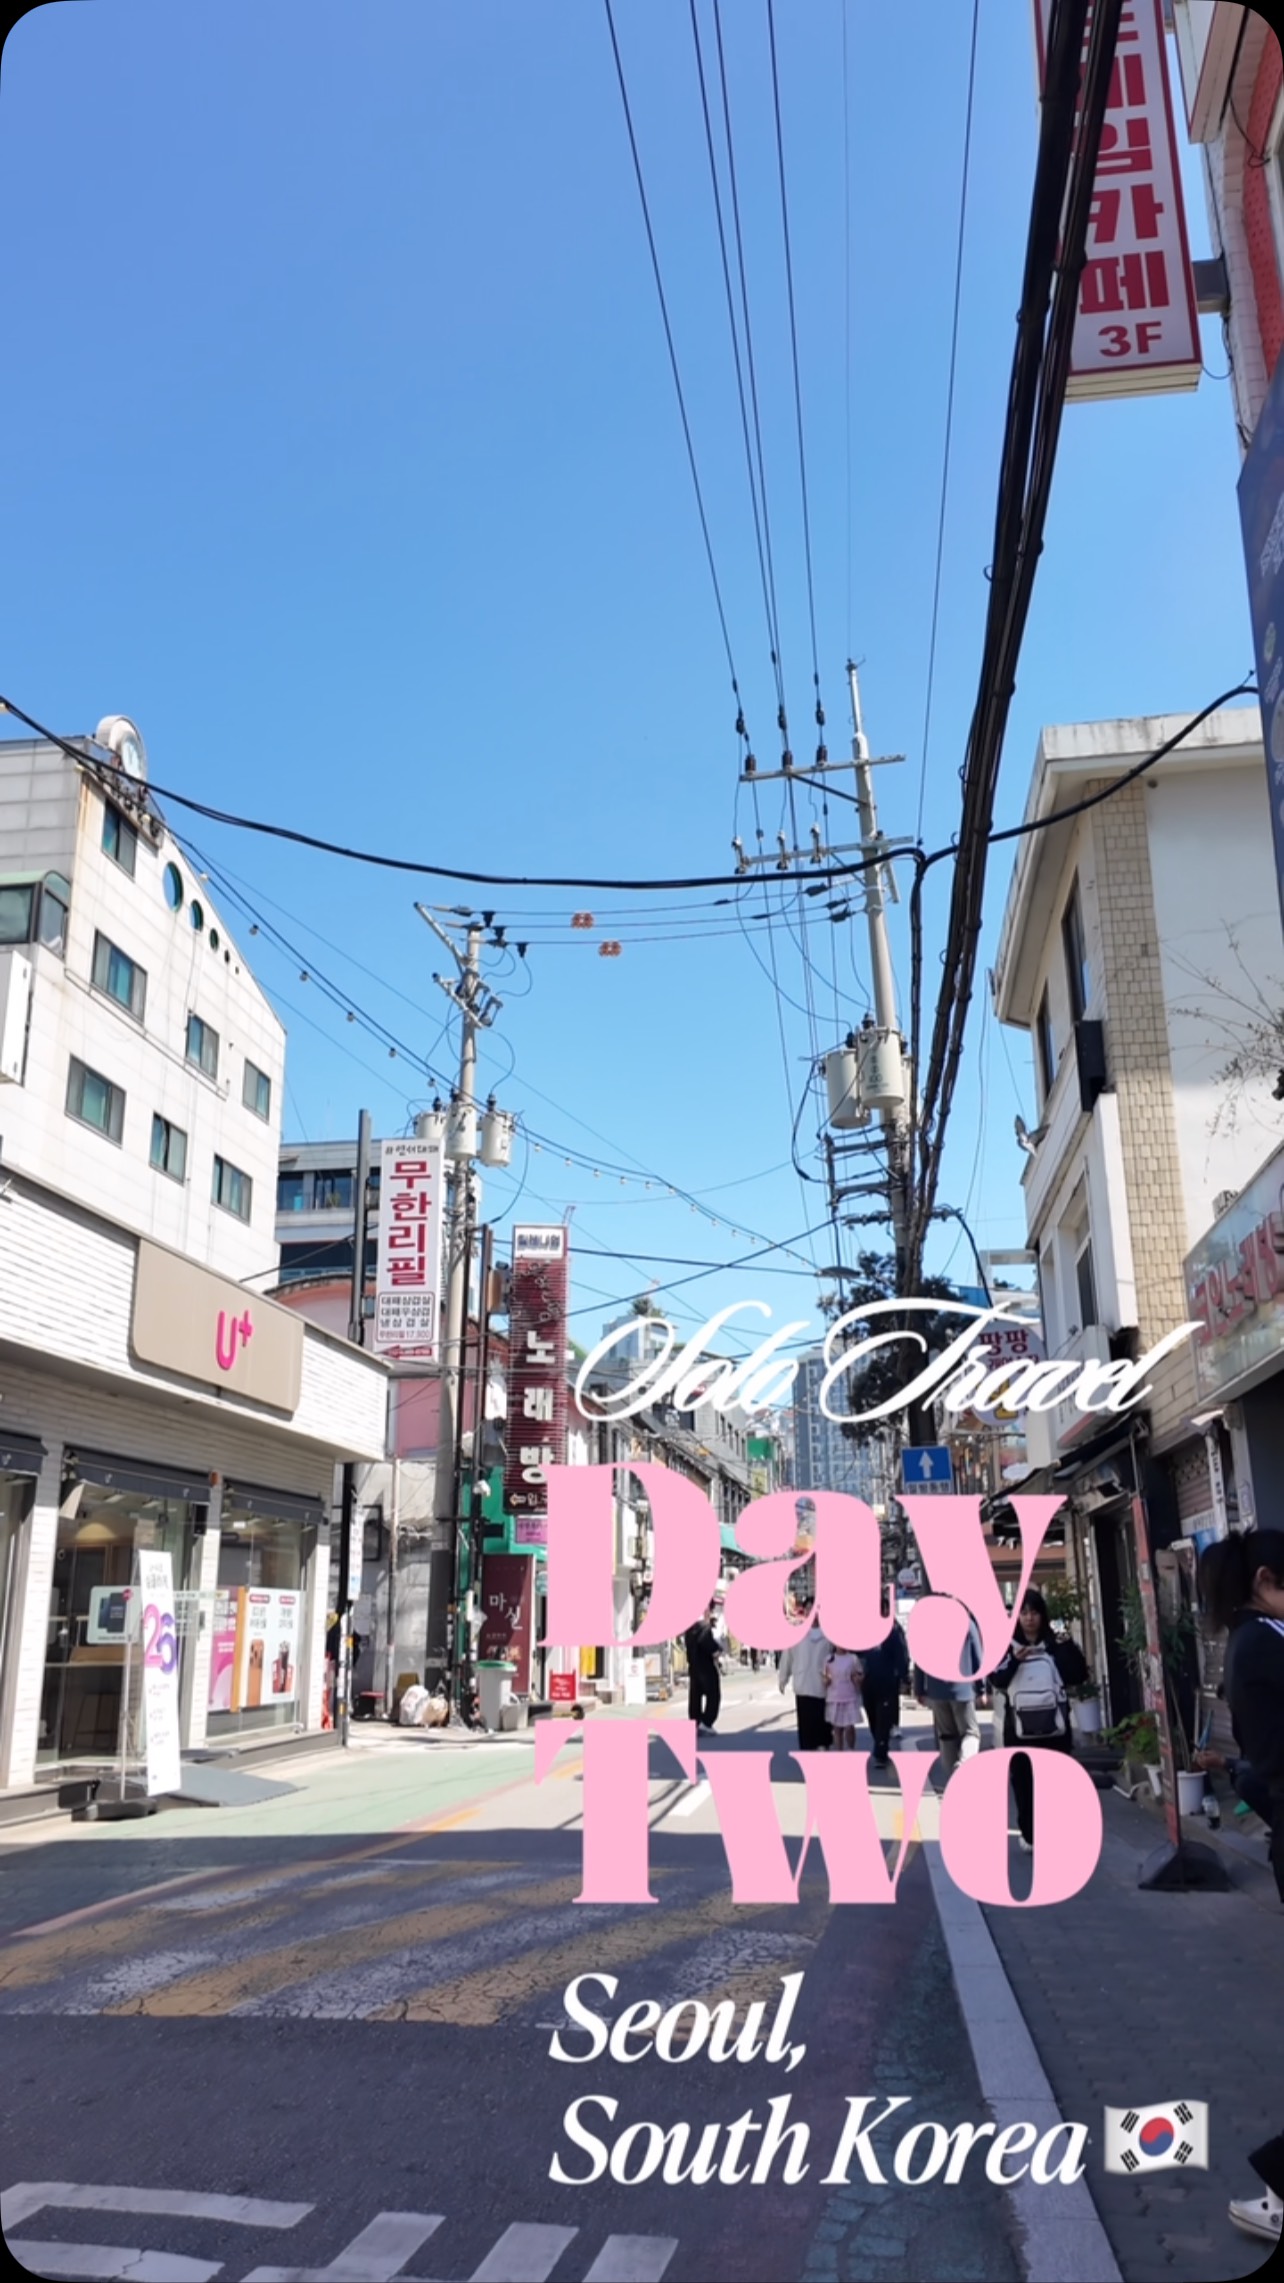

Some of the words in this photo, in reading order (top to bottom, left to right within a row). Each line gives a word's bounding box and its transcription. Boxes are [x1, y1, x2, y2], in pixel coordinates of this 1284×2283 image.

[1098, 321, 1162, 358] 3F
[386, 1160, 432, 1286] 무한리필
[381, 1296, 431, 1306] 대패삼겹살
[215, 1310, 253, 1371] U+
[519, 1330, 556, 1485] 노래방
